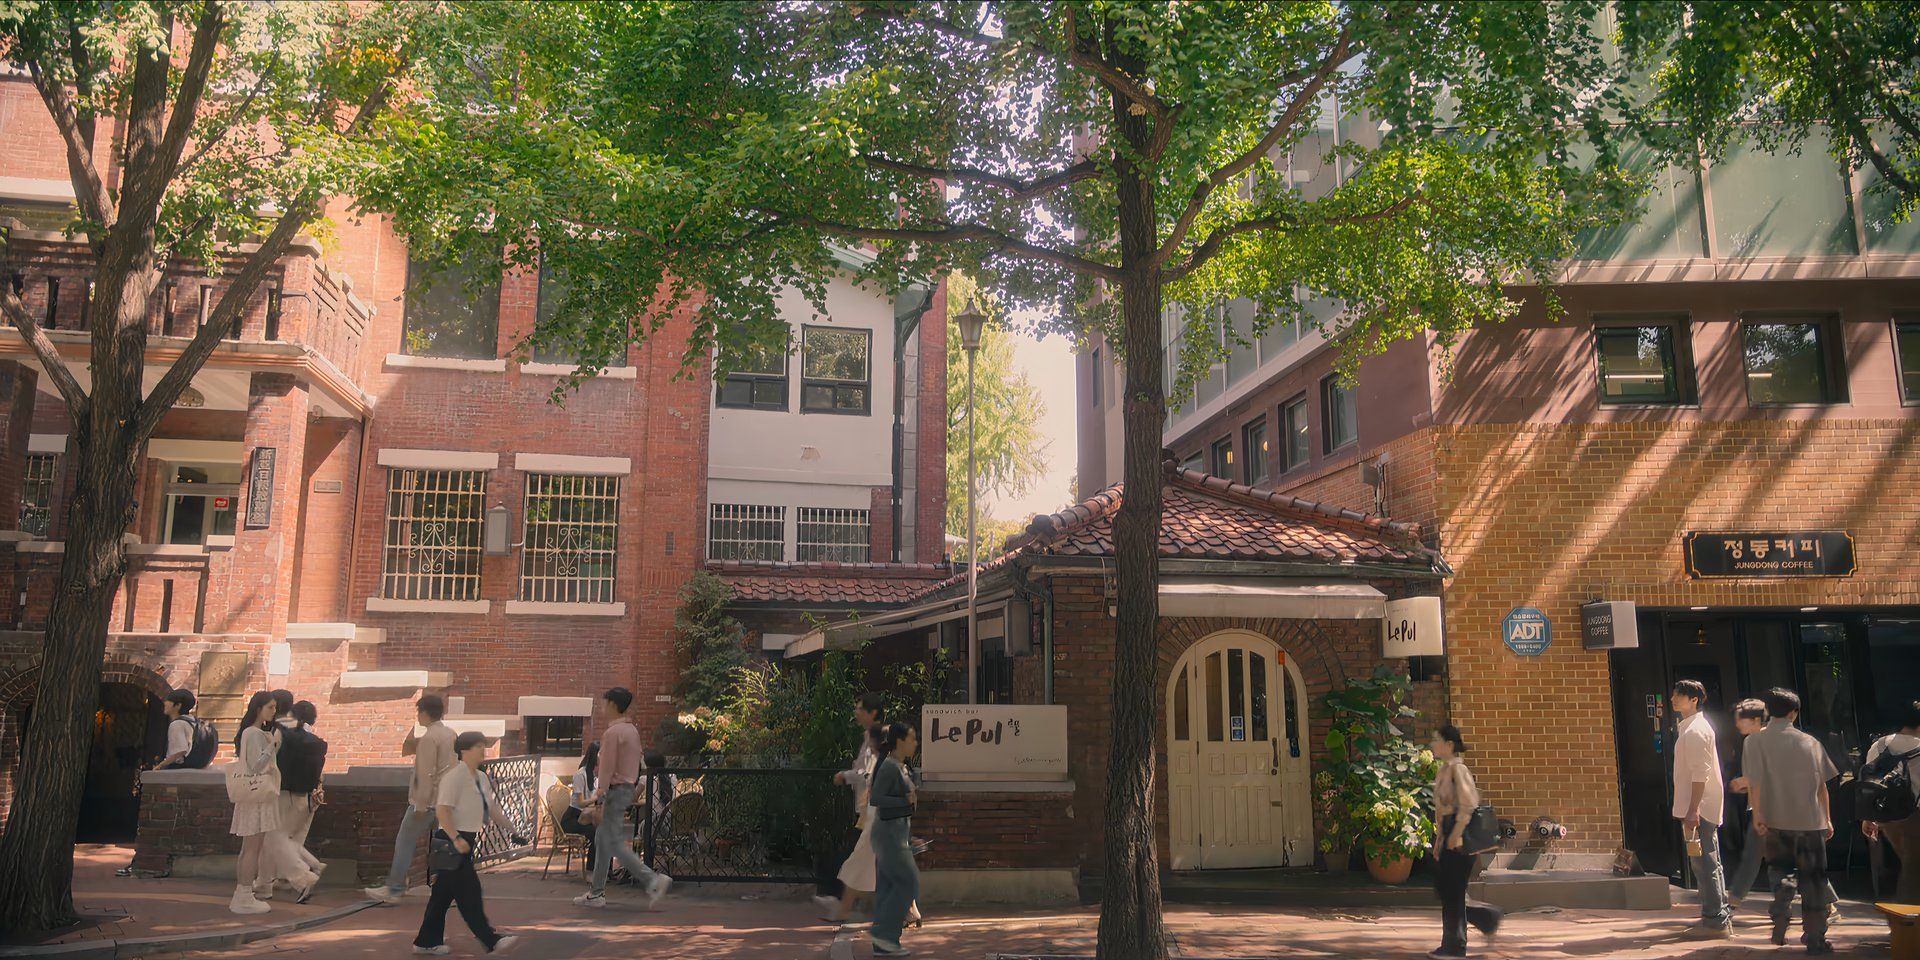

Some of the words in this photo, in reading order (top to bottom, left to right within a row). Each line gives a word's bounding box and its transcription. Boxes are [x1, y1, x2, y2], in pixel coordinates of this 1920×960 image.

[1723, 539, 1821, 559] 정동커피
[1734, 560, 1779, 569] JUNGDONG
[1781, 560, 1814, 569] COFFEE
[1510, 622, 1544, 640] ADT
[1590, 626, 1609, 636] COFFEE
[931, 717, 962, 743] Le
[965, 718, 1003, 746] Pul
